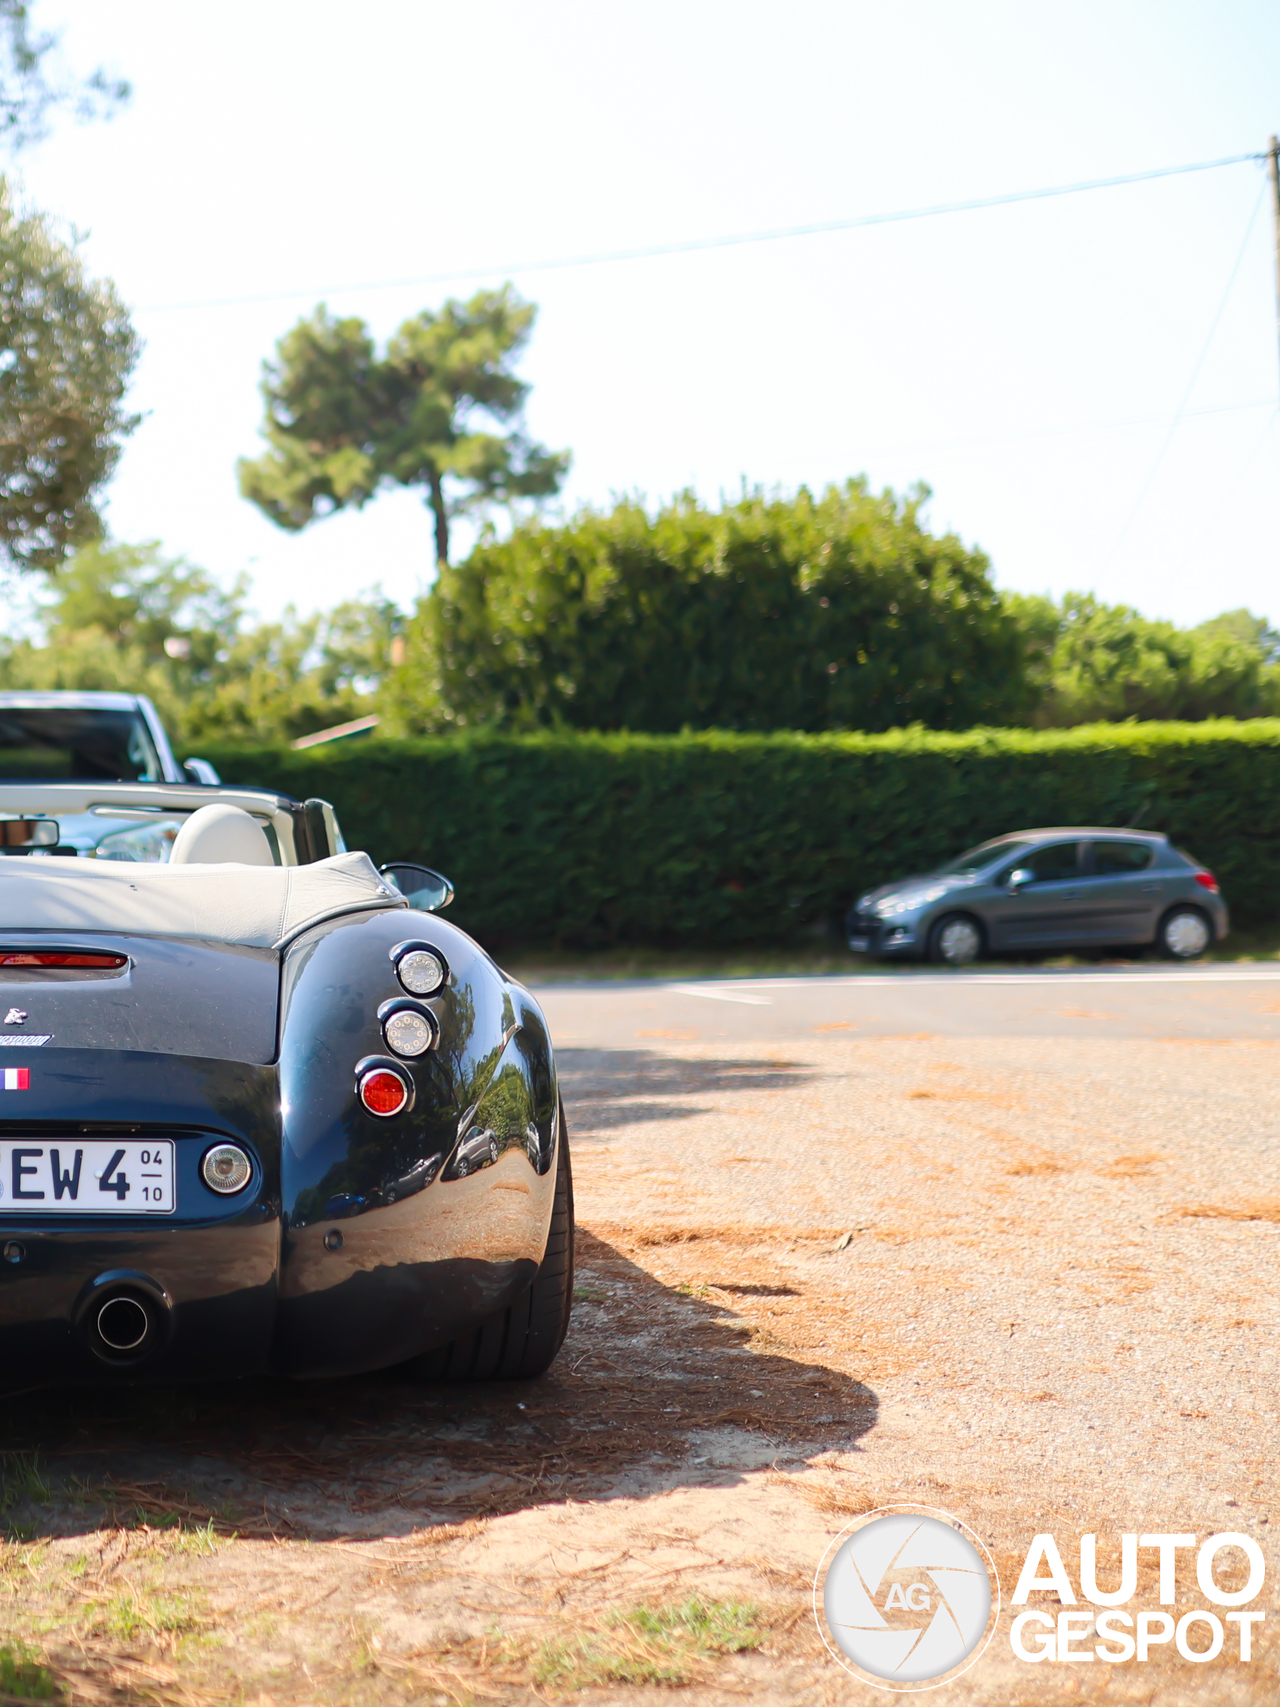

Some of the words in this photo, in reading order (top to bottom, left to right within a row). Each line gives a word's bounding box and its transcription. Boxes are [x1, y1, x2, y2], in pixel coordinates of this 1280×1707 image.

[141, 1150, 162, 1165] 04
[11, 1148, 83, 1200] EW
[98, 1149, 130, 1200] 4
[141, 1187, 162, 1201] 10
